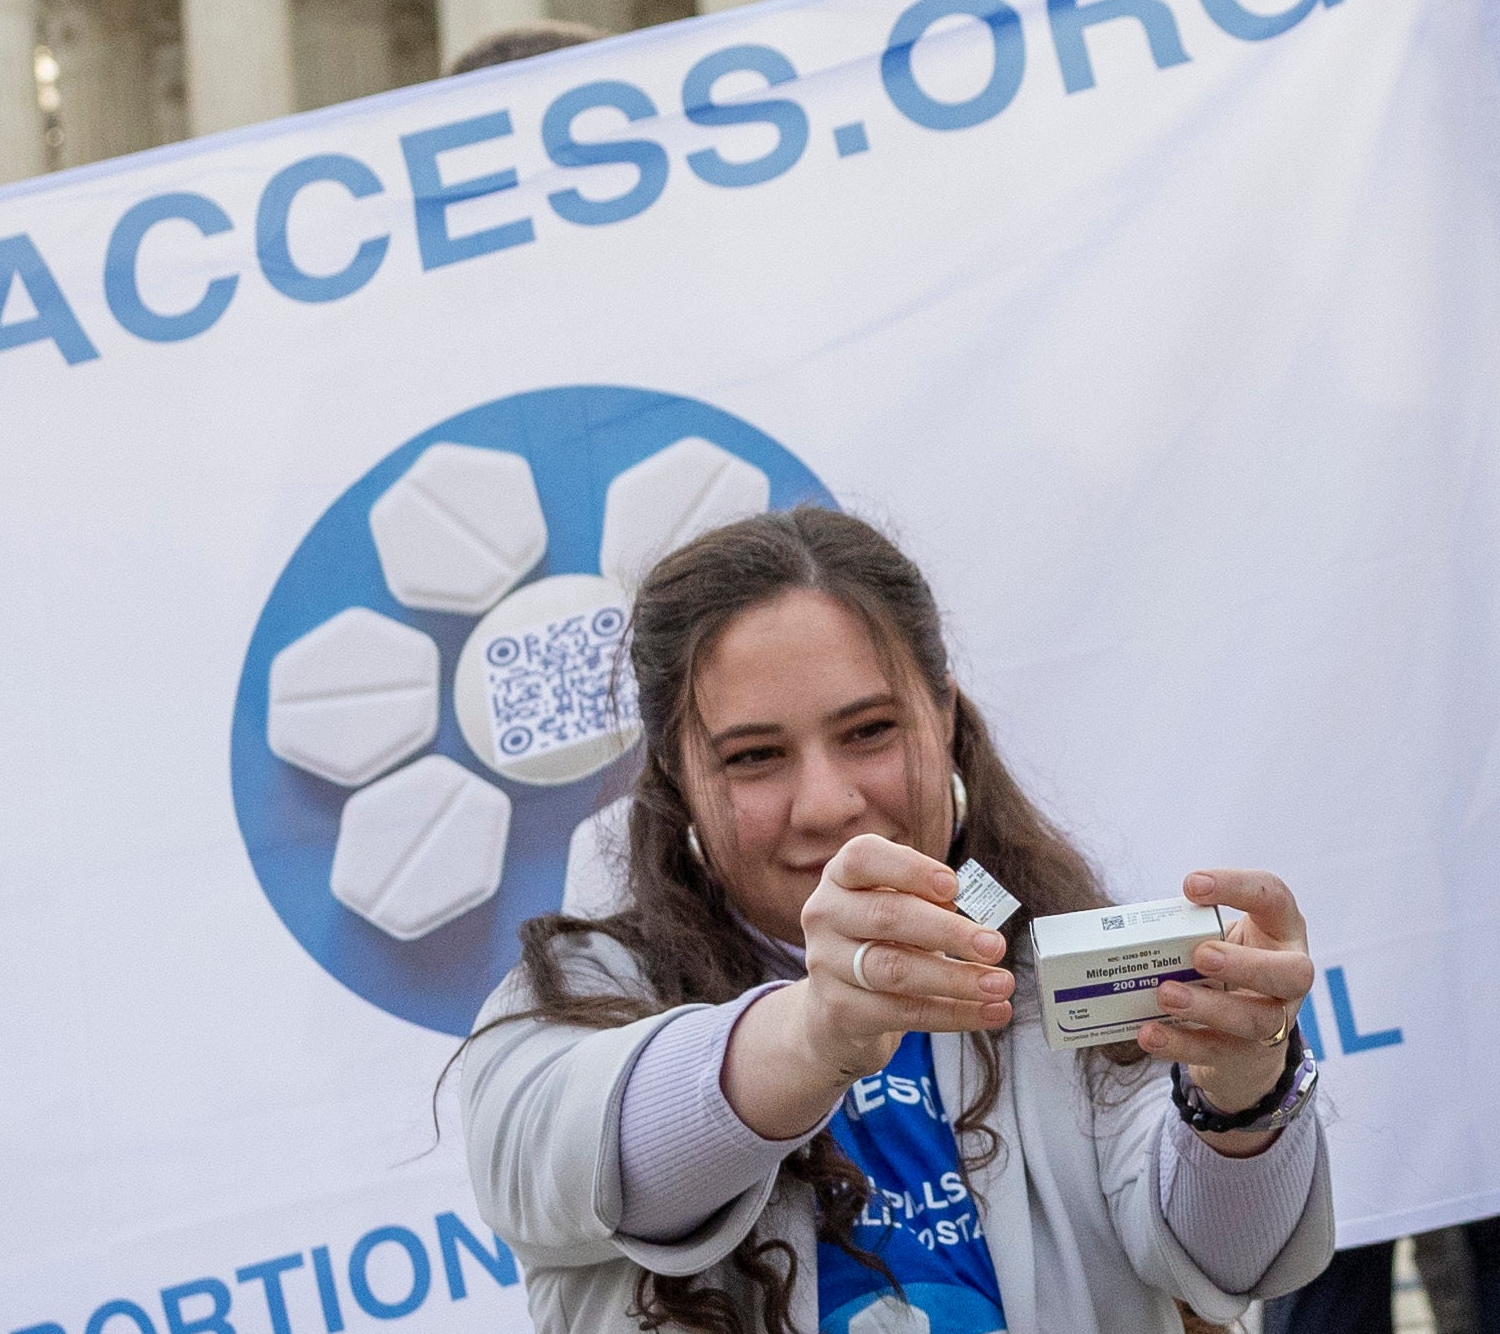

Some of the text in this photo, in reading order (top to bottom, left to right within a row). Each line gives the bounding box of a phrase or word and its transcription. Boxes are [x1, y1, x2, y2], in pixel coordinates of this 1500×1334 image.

[1086, 956, 1182, 979] Mifepristone Tablet
[1112, 977, 1159, 991] 200 mg
